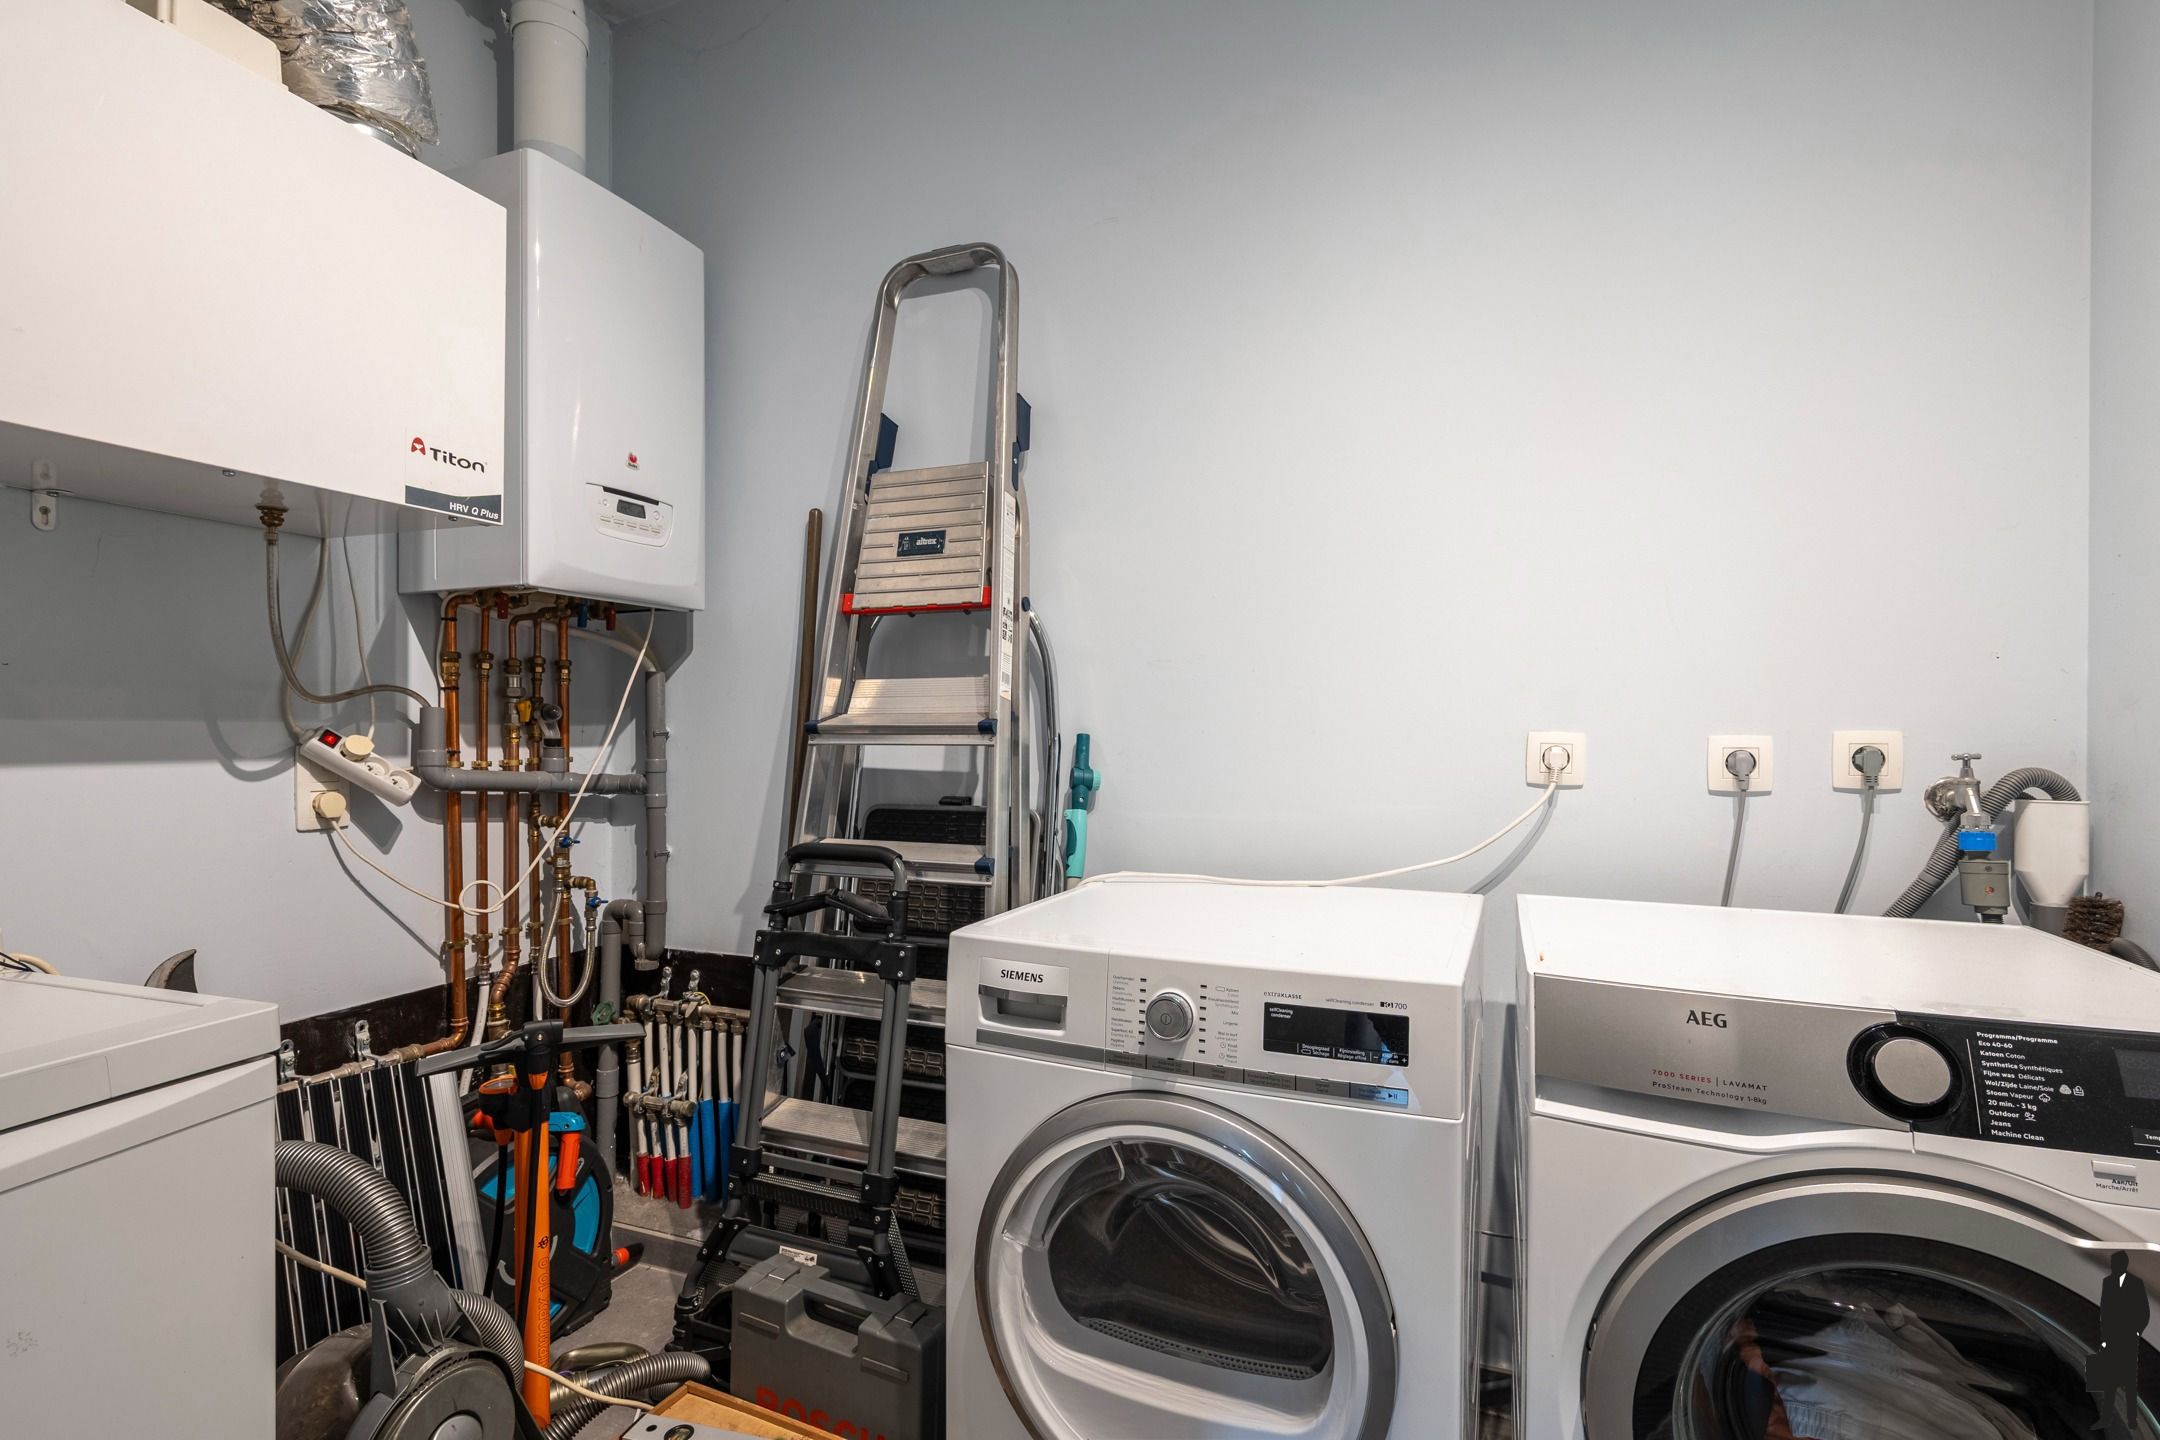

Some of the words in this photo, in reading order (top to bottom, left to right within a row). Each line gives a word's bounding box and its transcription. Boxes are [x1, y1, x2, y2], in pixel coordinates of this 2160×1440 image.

[429, 447, 485, 473] Titon
[449, 502, 469, 513] HRV
[471, 507, 479, 516] Q
[480, 509, 499, 520] Plus
[1000, 969, 1044, 983] SIEMENS
[1263, 991, 1303, 1000] extraKLASSE
[1686, 1010, 1728, 1028] AEG
[1976, 1031, 2058, 1044] Programma/Programme
[1980, 1050, 2004, 1058] Katoen
[2005, 1052, 2026, 1060] Coton
[1981, 1060, 2018, 1070] Synthetica
[2018, 1063, 2063, 1074] Synthétiques
[1651, 1069, 1675, 1078] 7000
[1679, 1073, 1712, 1083] SERIES
[1723, 1080, 1768, 1091] LAVAMAT
[1983, 1070, 2000, 1078] Fijne
[2018, 1073, 2045, 1082] Délicats
[1985, 1080, 2018, 1089] Wol/Zijde
[2019, 1082, 2054, 1092] Laine/Soie
[1652, 1081, 1692, 1093] ProSteam
[1696, 1087, 1744, 1101] Technology
[1746, 1096, 1767, 1105] 1-8kg
[1986, 1089, 2008, 1097] Stoom
[2009, 1091, 2034, 1100] Vapeur
[1988, 1109, 2020, 1118] Outdoor
[2027, 1103, 2037, 1112] kg
[1990, 1120, 2012, 1128] Jeans
[1991, 1129, 2022, 1139] Machine
[2023, 1133, 2045, 1141] Clean
[2096, 1183, 2138, 1192] Marche/Arrêt
